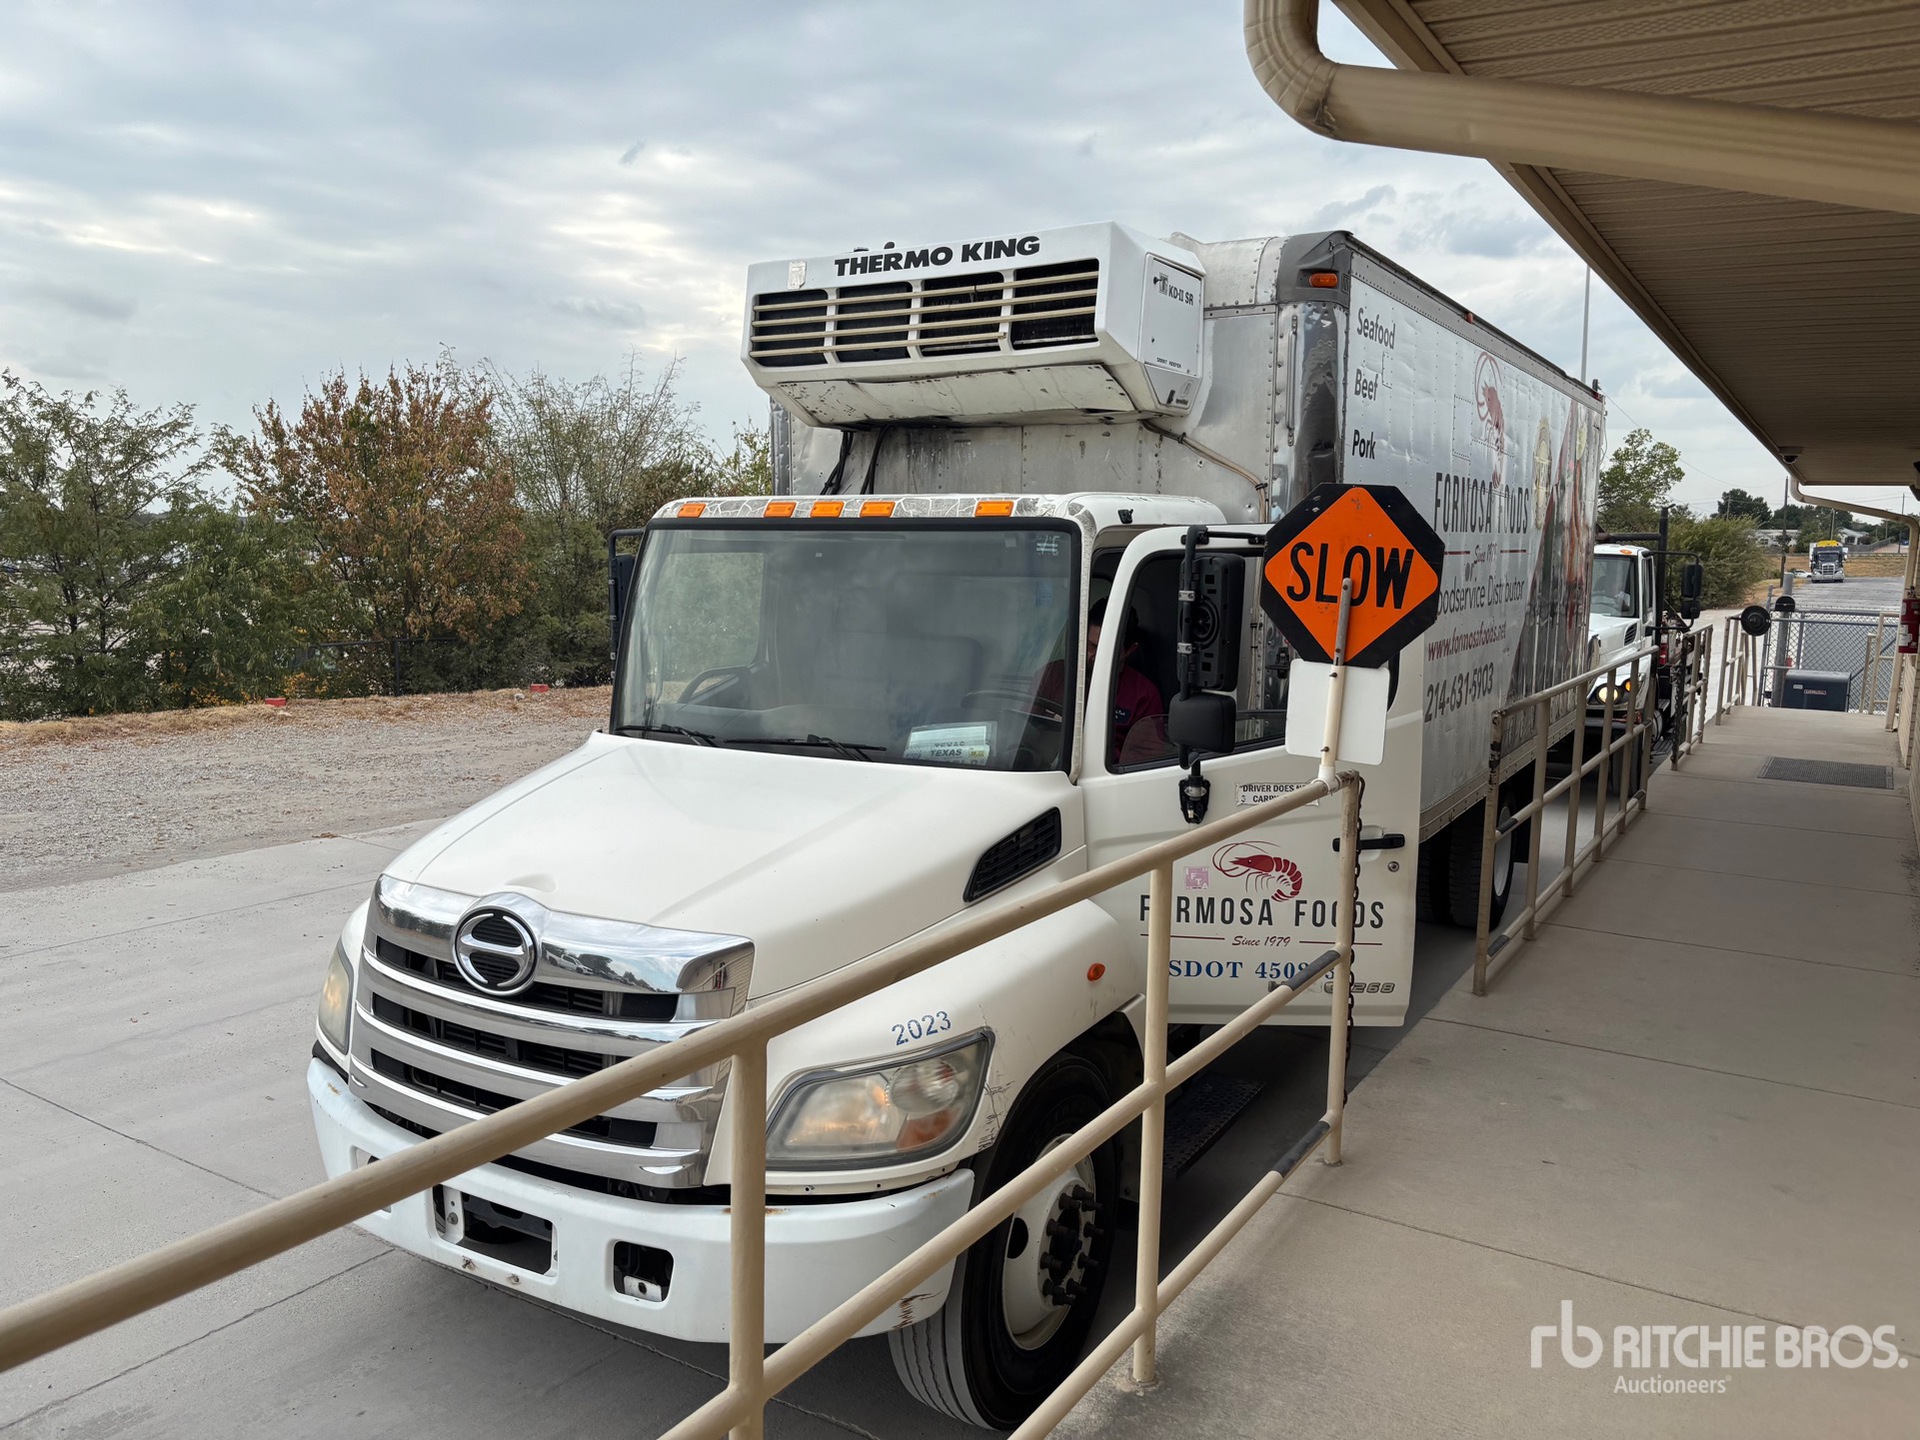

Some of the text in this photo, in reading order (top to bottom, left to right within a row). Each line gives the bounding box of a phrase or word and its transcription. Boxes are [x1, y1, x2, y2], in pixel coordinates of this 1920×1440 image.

[834, 235, 1040, 277] THERMO KING
[1356, 307, 1396, 350] Seafood
[1354, 368, 1379, 401] Beef
[1351, 429, 1377, 460] Pork
[1434, 472, 1493, 533] FORMOSA
[1286, 541, 1415, 610] SLOW
[1424, 662, 1494, 723] 214-631-5903
[930, 748, 963, 757] TEXAS
[1242, 784, 1271, 793] DRIVER
[1273, 784, 1294, 793] DOES
[1139, 894, 1273, 926] FRMOSA
[1232, 935, 1291, 947] Since 1979
[1168, 960, 1243, 978] SDOT
[1351, 982, 1396, 994] 268
[891, 1010, 951, 1046] 2023
